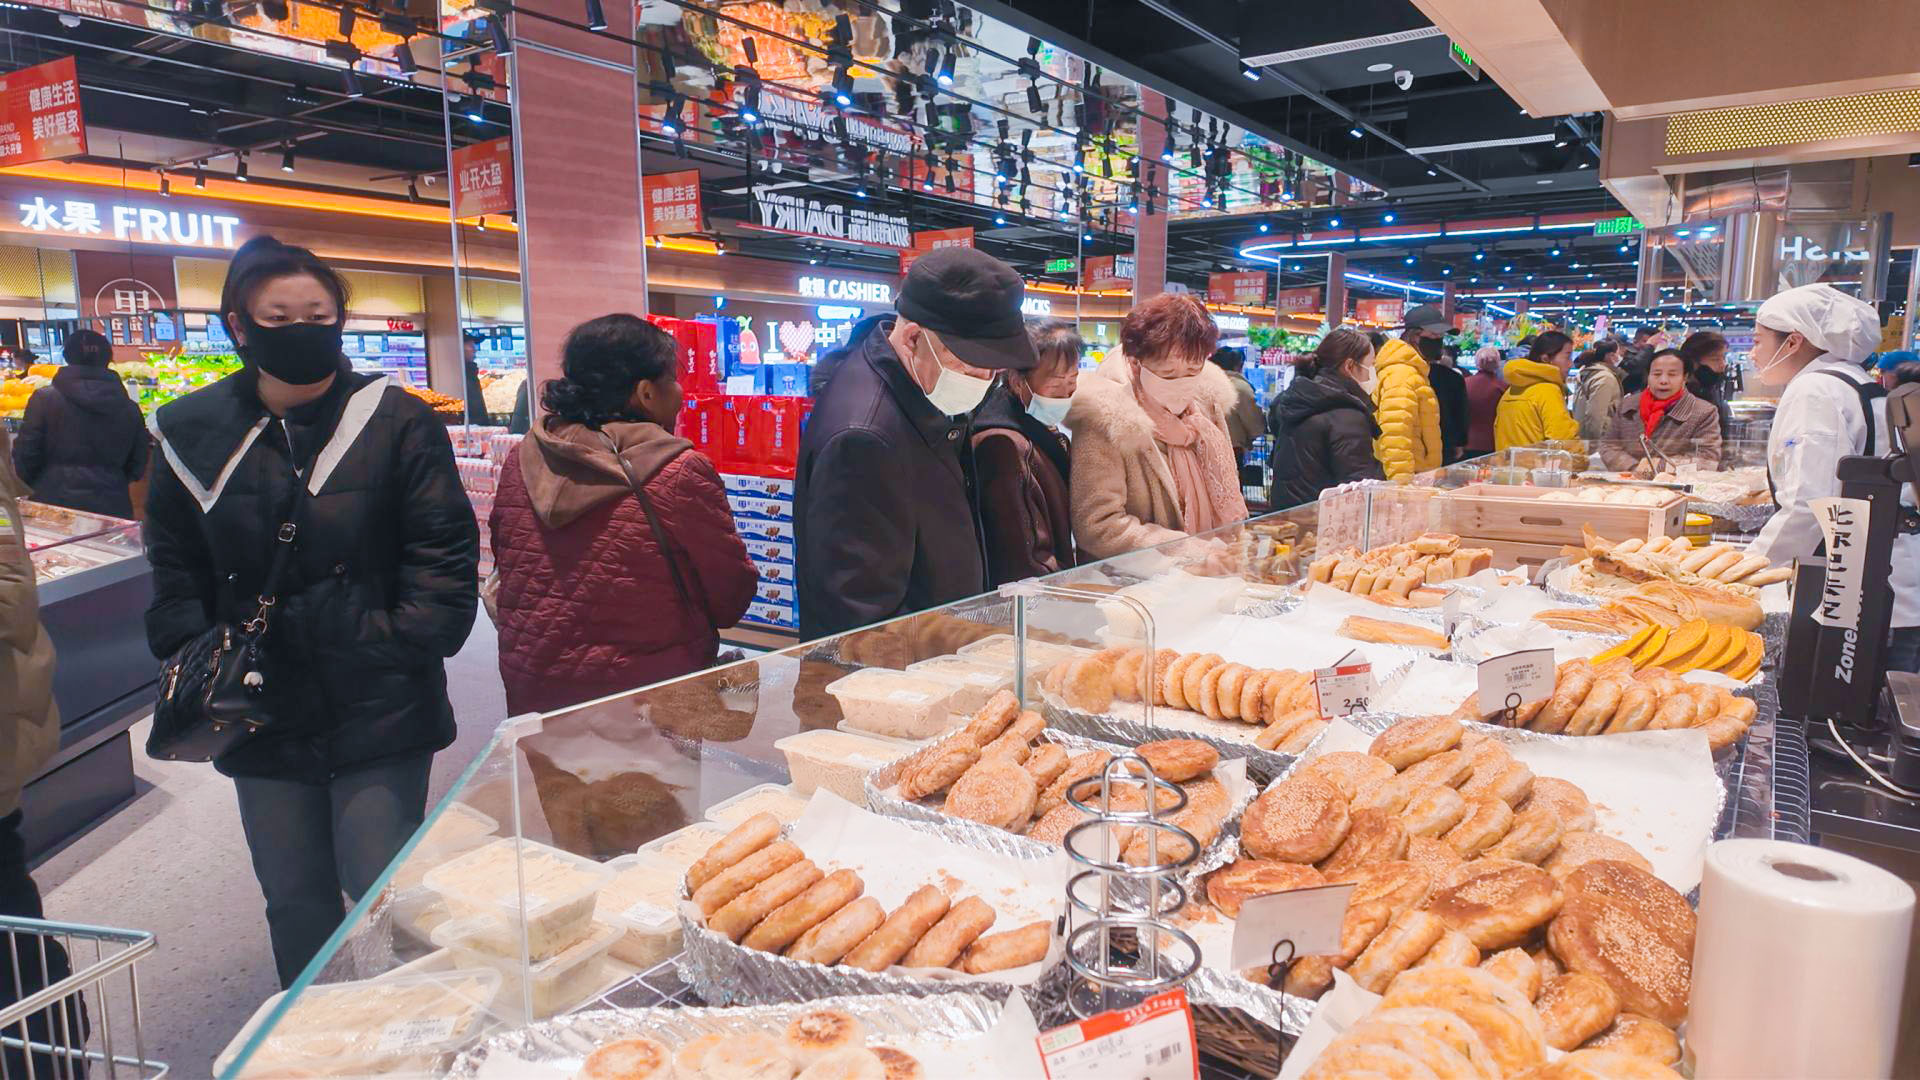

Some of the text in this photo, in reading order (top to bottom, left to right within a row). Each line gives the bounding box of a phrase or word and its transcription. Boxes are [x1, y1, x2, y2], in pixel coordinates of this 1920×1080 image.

[29, 79, 76, 112] 健康生活
[32, 109, 80, 141] 美好爱家
[652, 184, 697, 204] 健康生活
[19, 196, 240, 248] 水果 FRUIT
[828, 279, 891, 303] CASHIER
[766, 321, 779, 353] I
